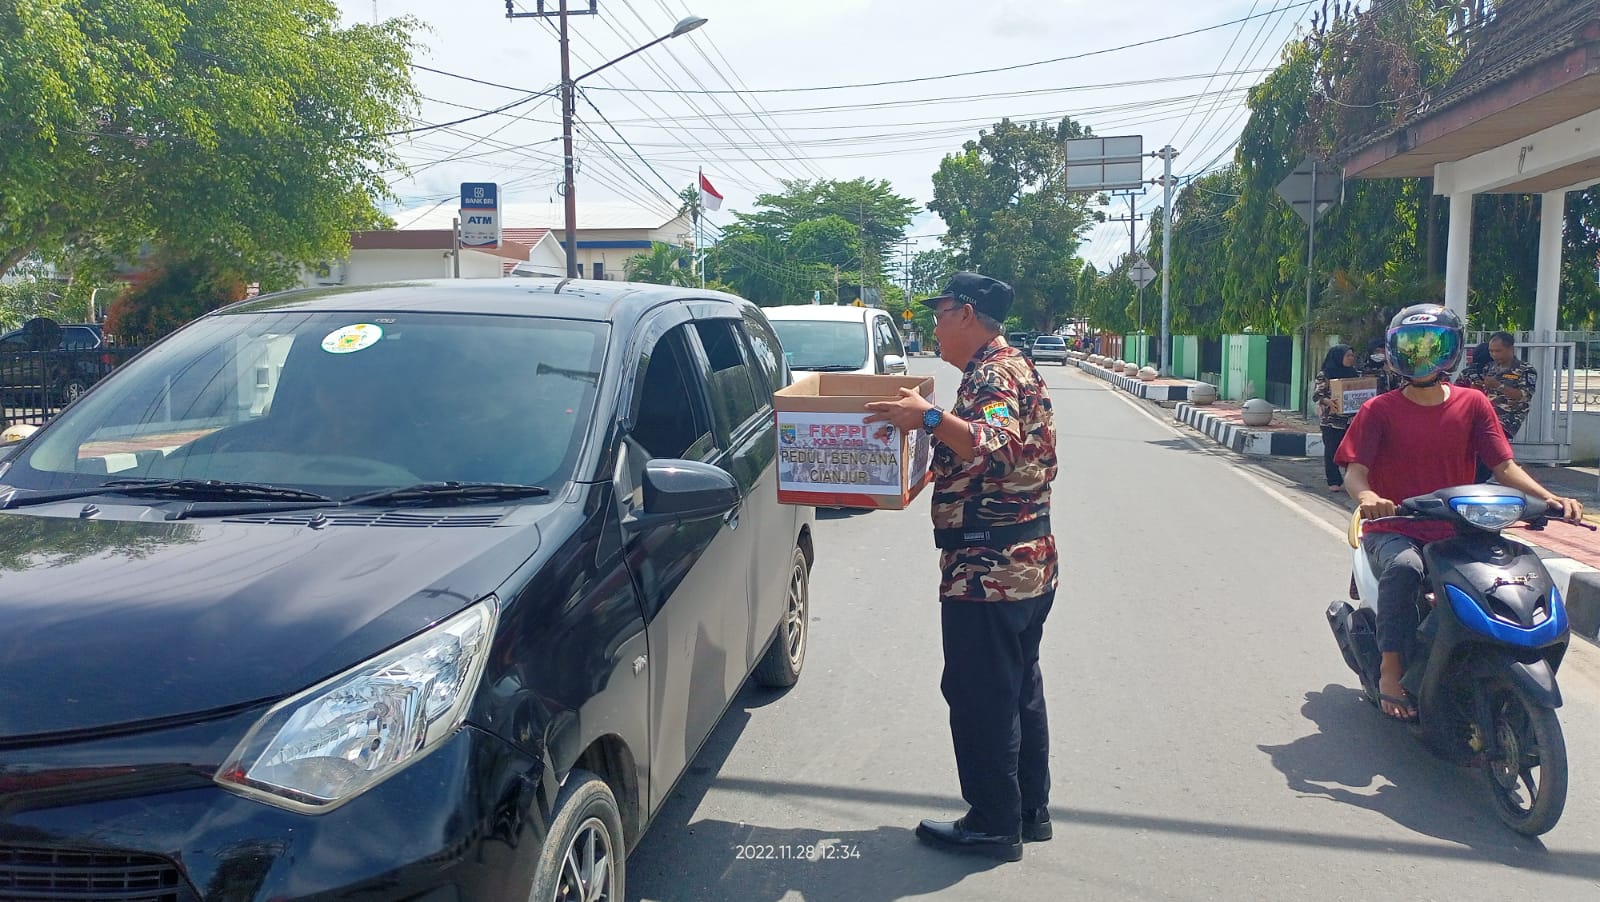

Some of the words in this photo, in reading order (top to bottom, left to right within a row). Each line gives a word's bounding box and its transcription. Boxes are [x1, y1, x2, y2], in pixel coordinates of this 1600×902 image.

[467, 216, 492, 224] ATM
[809, 424, 867, 438] FKPPI
[781, 450, 828, 464] PEDULI
[832, 452, 898, 466] BENCANA
[810, 469, 868, 483] CIANJUR
